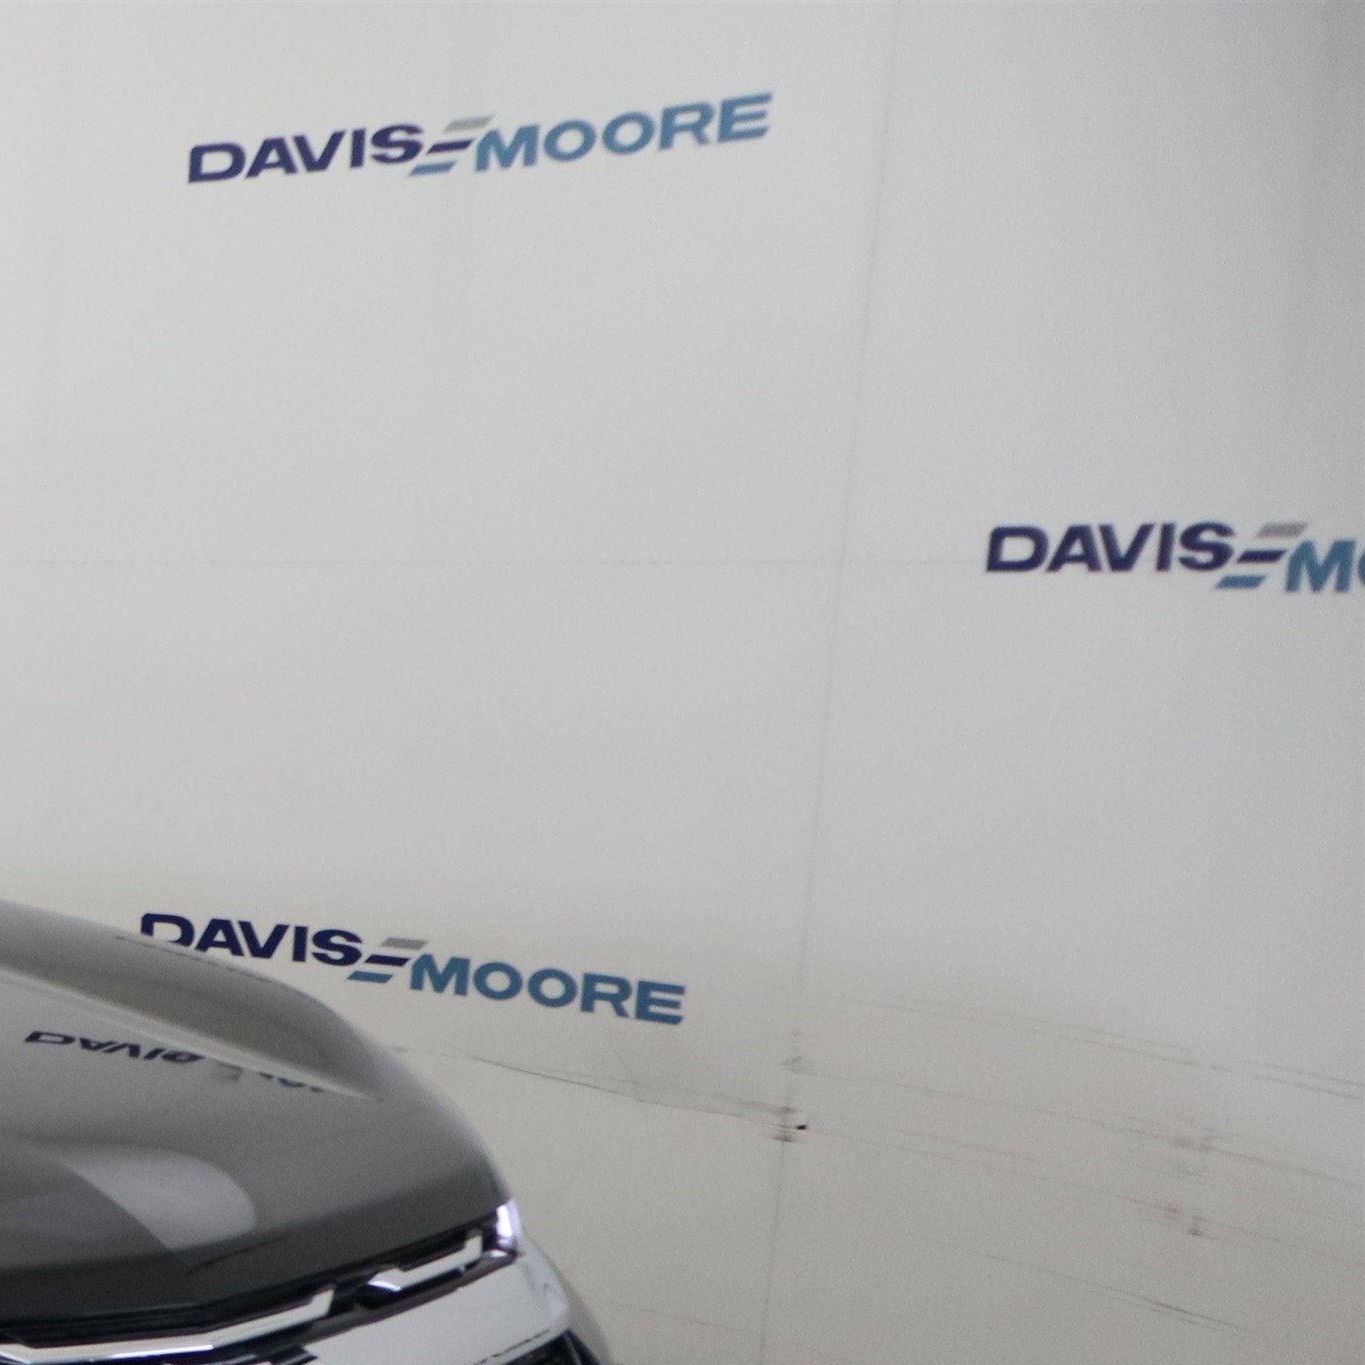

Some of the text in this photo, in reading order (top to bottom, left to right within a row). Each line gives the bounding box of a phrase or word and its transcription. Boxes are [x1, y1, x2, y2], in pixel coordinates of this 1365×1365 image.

[188, 92, 774, 184] DAVIS MOORE
[986, 521, 1365, 594] DAVIS M
[140, 912, 687, 1026] DAVIS MOORE
